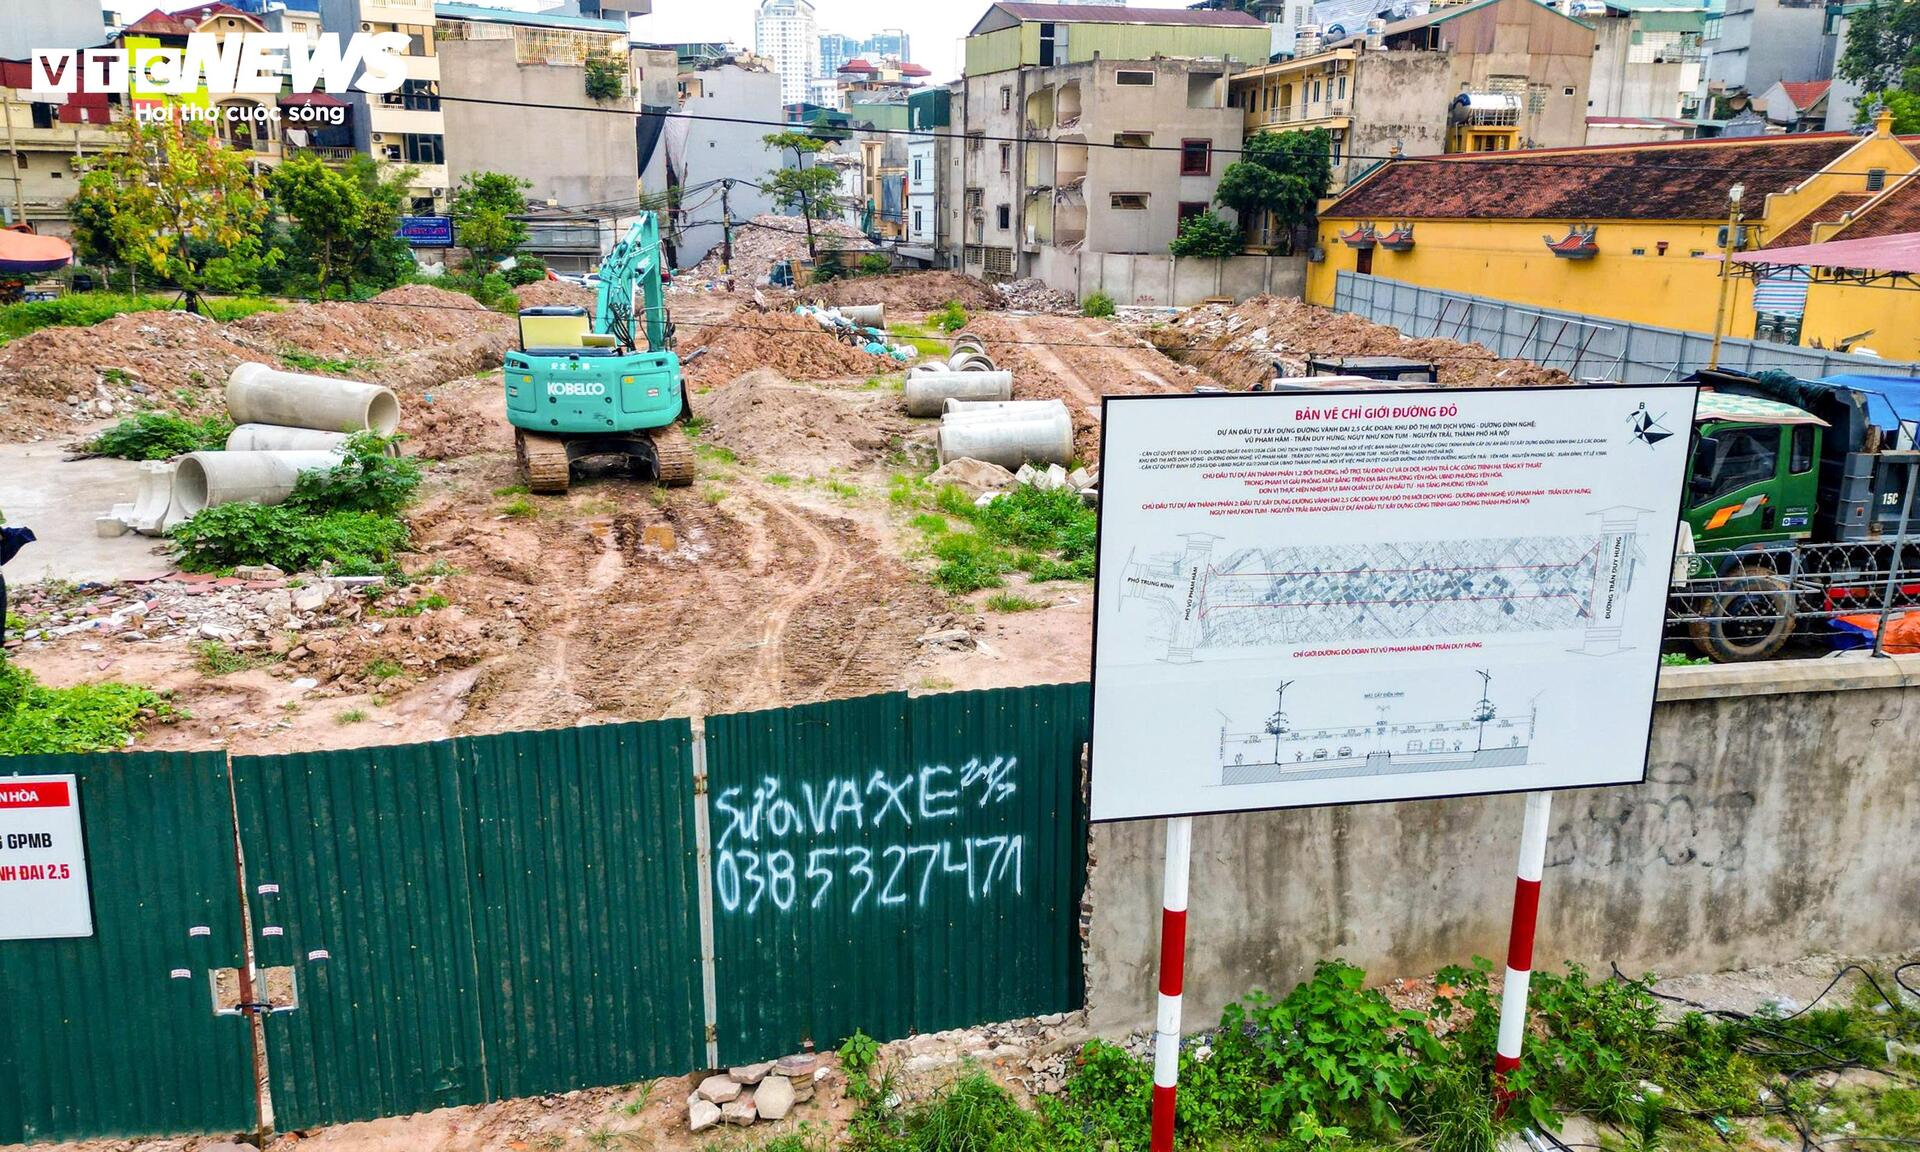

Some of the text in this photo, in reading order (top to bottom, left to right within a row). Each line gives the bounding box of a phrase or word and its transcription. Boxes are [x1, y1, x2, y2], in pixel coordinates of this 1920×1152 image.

[547, 382, 605, 395] KOBELCO
[1294, 406, 1320, 420] BẢN
[1340, 405, 1361, 419] CHỈ
[1364, 404, 1390, 418] GIỚI
[1392, 403, 1437, 417] ĐƯỜNG
[1438, 402, 1457, 416] ĐỎ
[1639, 402, 1646, 410] B
[1882, 492, 1899, 505] 15C
[1140, 579, 1159, 587] TRUNG
[9, 789, 39, 802] HÒA
[7, 833, 52, 849] GPMB
[19, 865, 44, 880] ĐAI
[47, 864, 70, 879] 2.5
